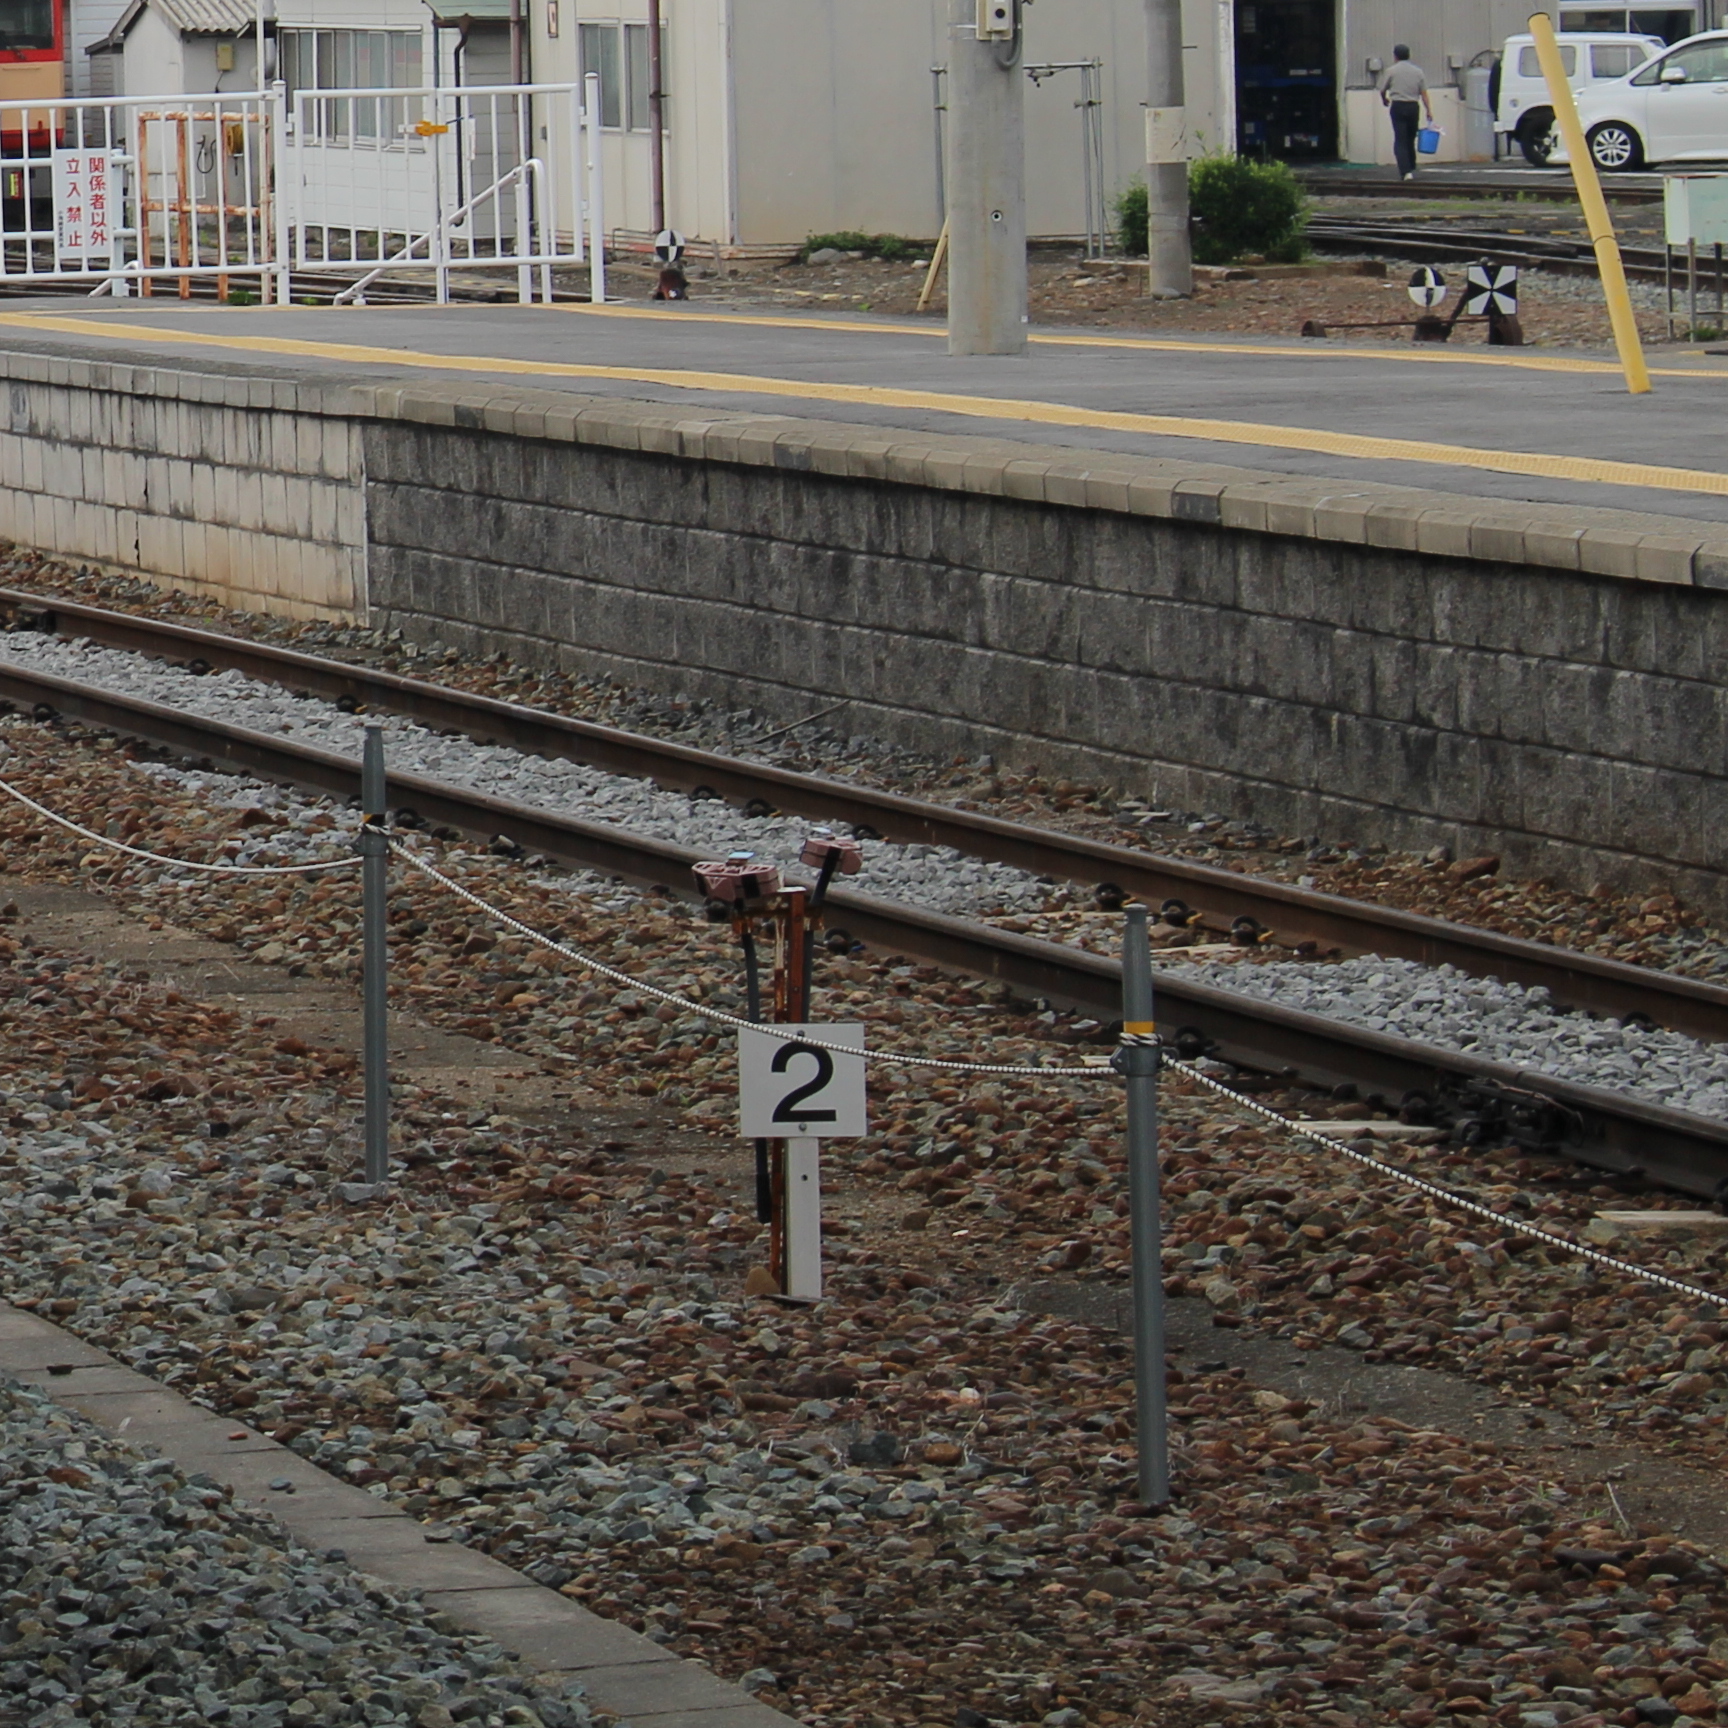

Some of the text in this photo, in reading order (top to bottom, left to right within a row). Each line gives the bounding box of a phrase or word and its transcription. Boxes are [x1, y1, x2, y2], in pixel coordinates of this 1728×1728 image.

[65, 157, 83, 248] 立入禁止
[88, 156, 108, 247] 関係者以外
[770, 1041, 837, 1123] 2
